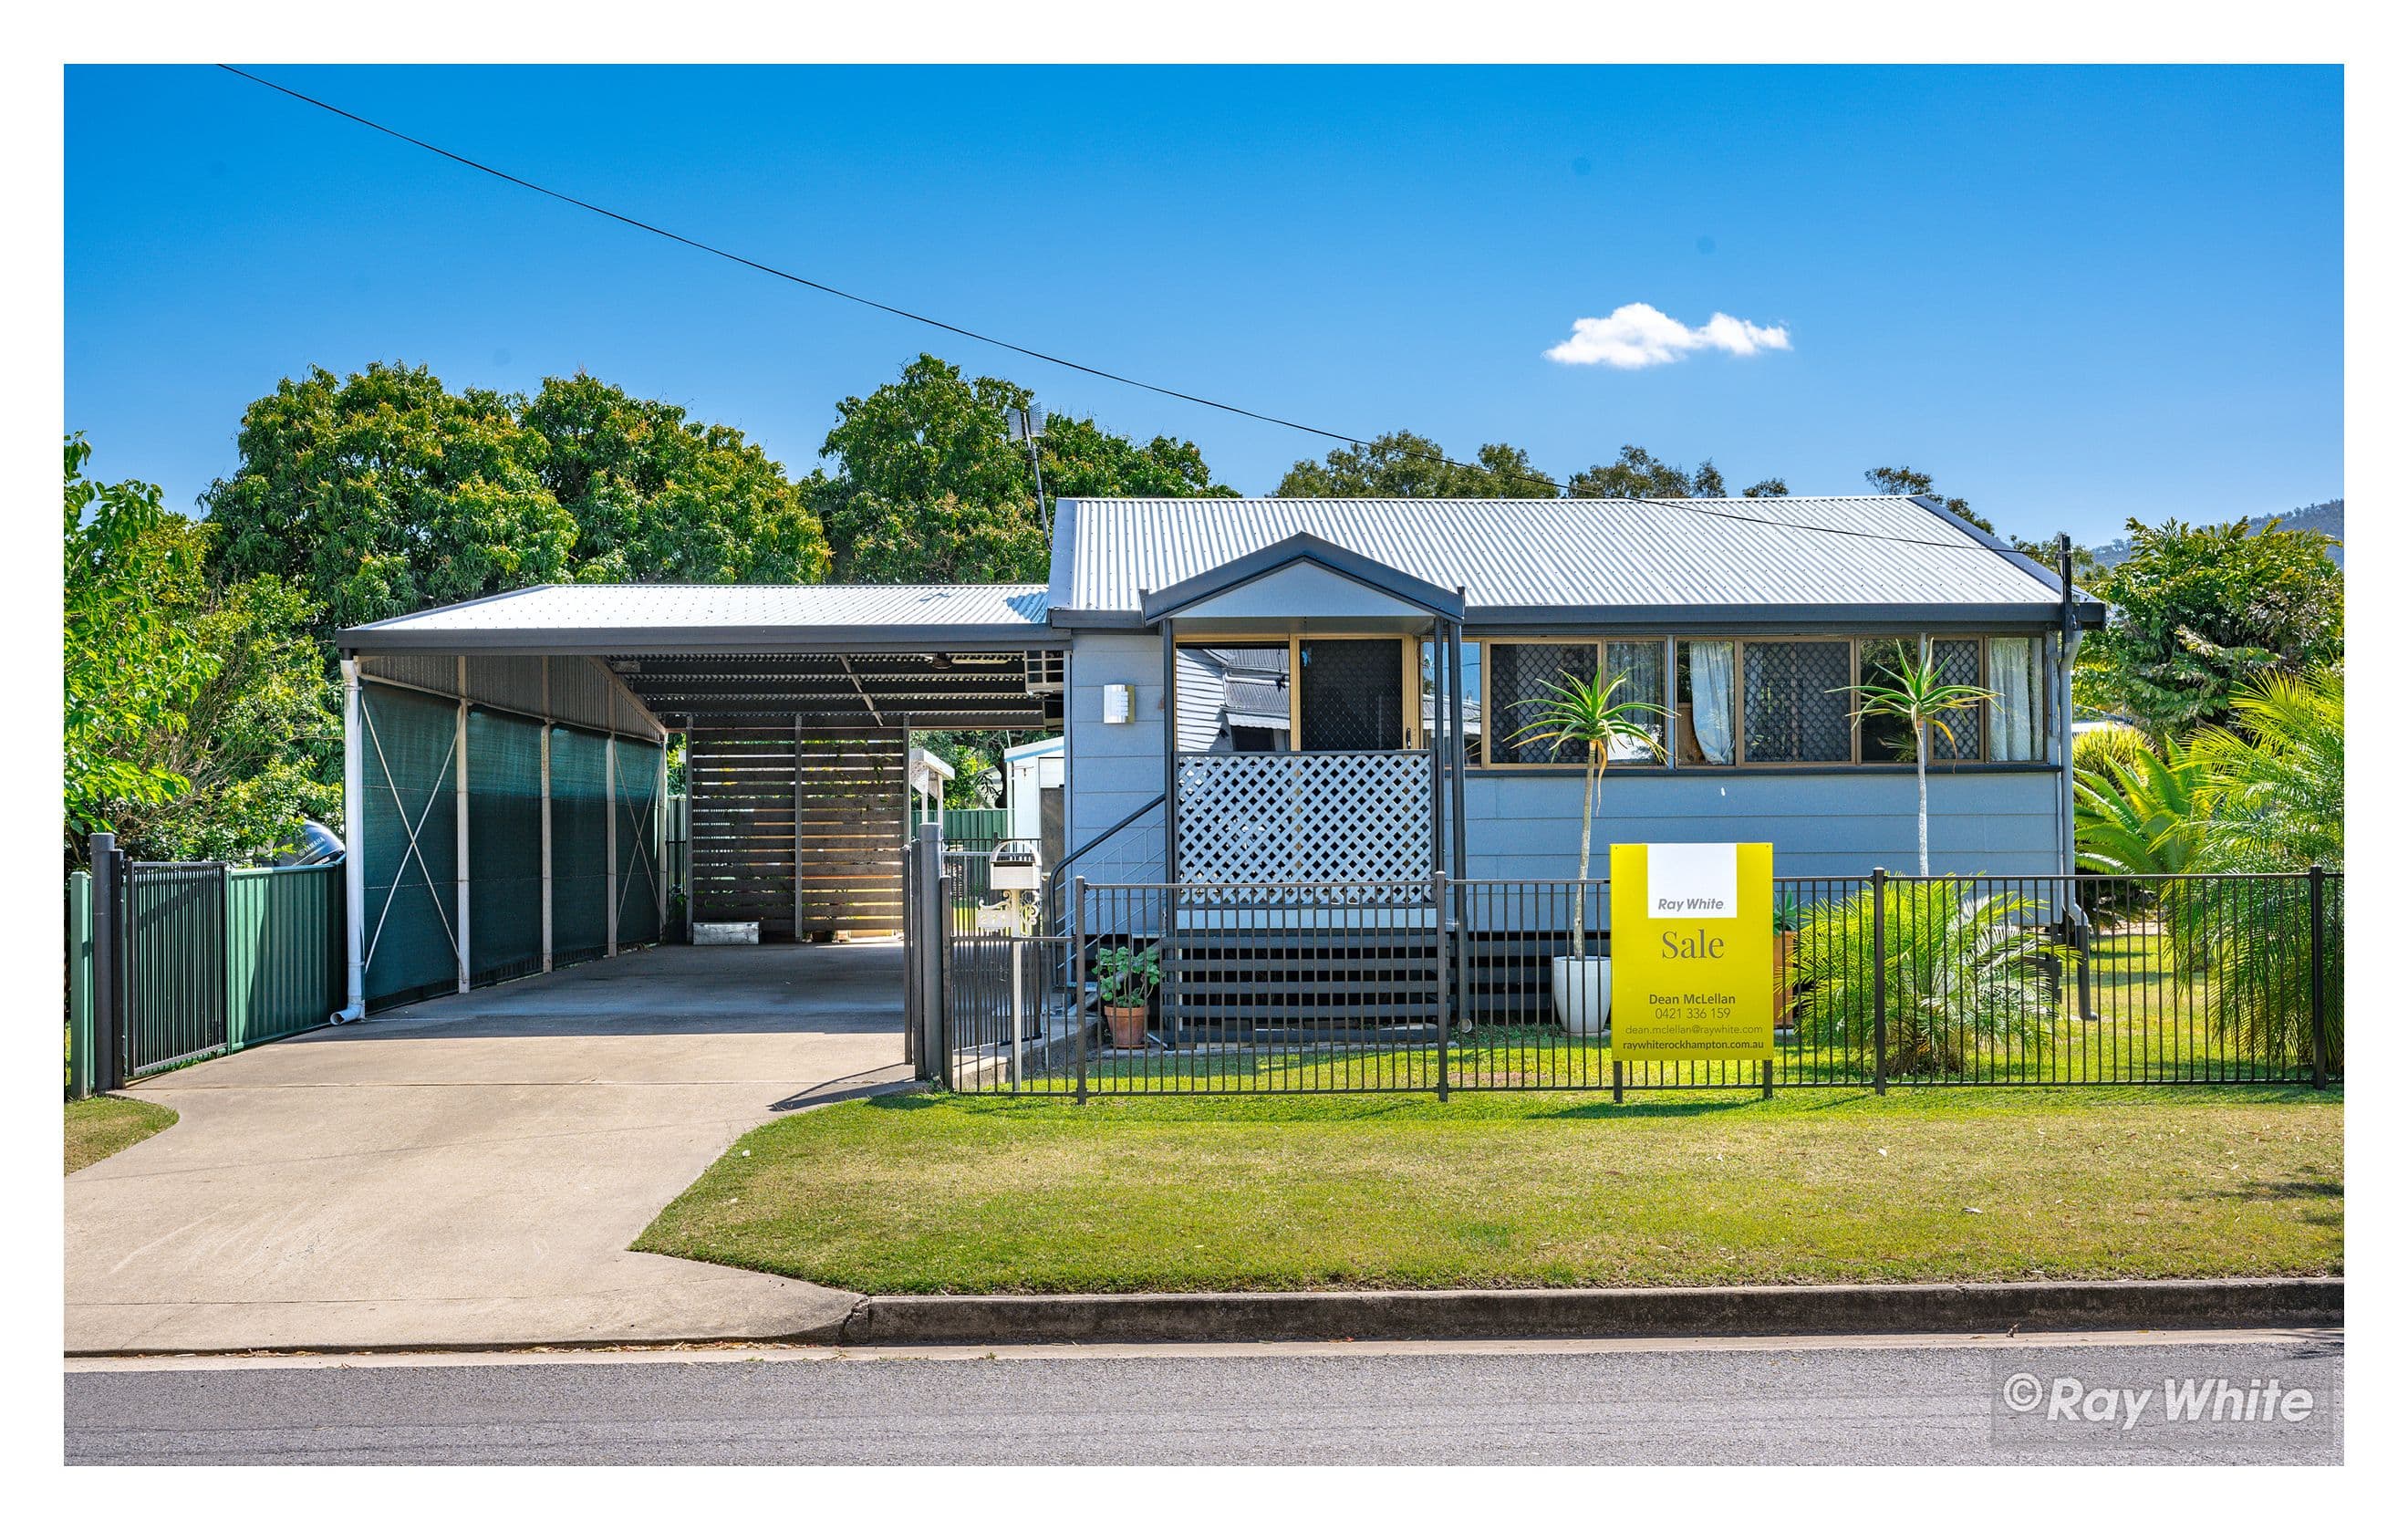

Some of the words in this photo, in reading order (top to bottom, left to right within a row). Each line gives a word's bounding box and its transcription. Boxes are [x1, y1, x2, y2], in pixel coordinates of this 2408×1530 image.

[1658, 898, 1684, 911] Ray
[1687, 898, 1724, 910] White
[1662, 929, 1724, 959] Sale
[1649, 994, 1679, 1004] Dean
[1684, 994, 1736, 1004] McLellan
[1656, 1008, 1682, 1019] 0421
[1687, 1008, 1707, 1019] 336
[1711, 1008, 1731, 1019] 159
[1625, 1024, 1763, 1036] dean.mclellan@raywhite.com
[1623, 1039, 1764, 1050] raywhiterockhampton.com.au
